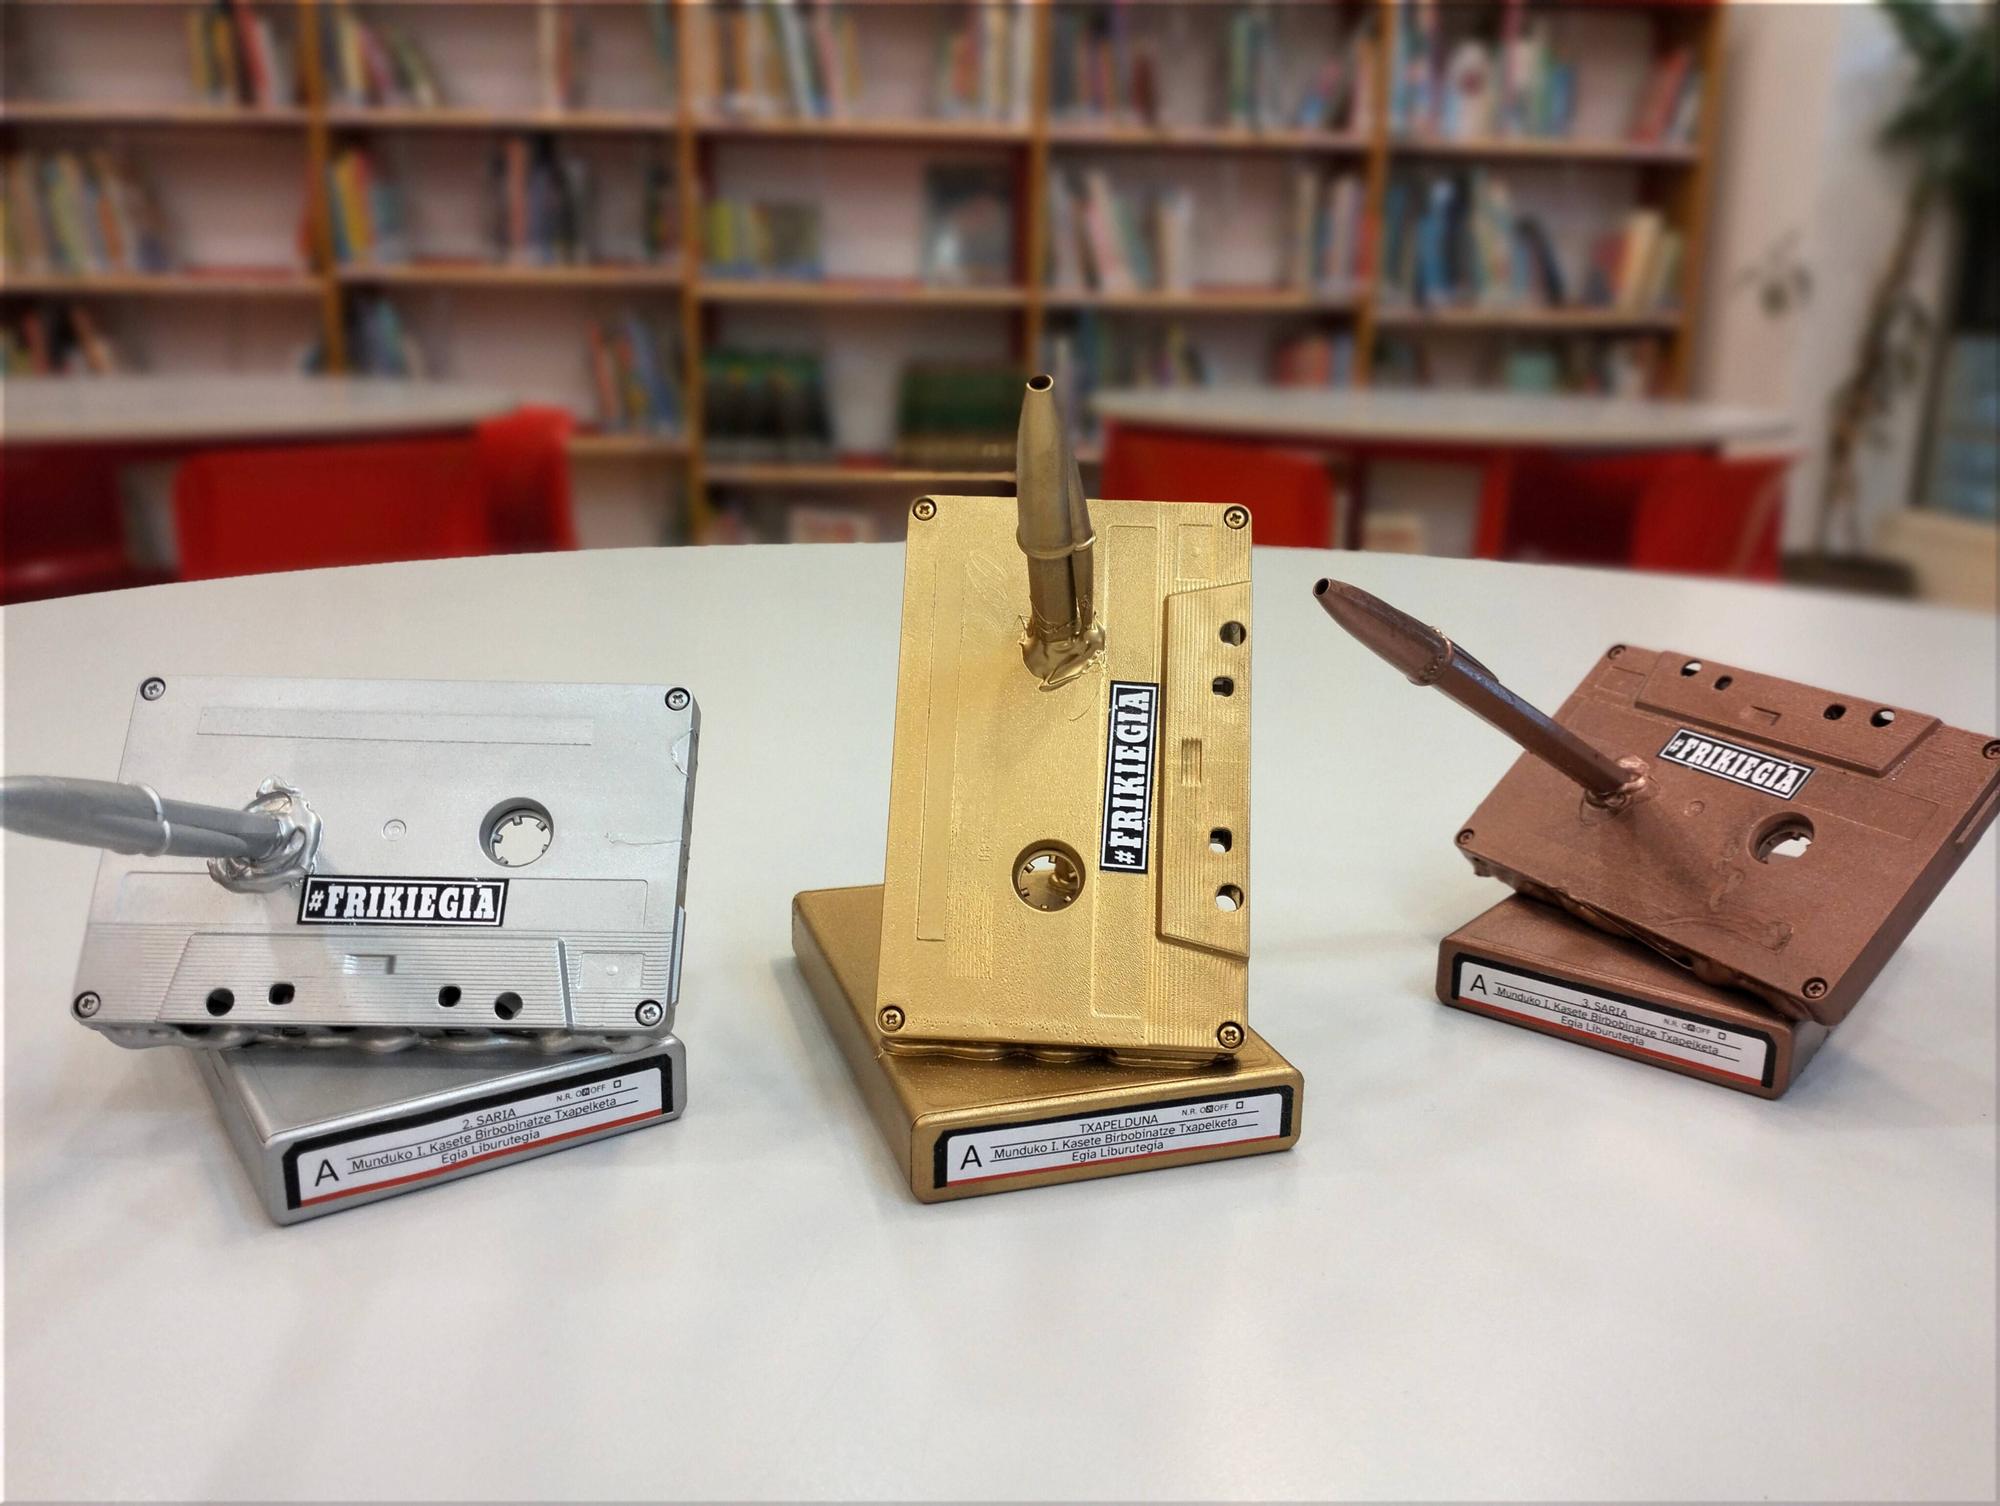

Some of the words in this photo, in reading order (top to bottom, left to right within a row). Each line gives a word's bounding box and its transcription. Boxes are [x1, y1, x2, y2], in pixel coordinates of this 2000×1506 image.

[1109, 691, 1150, 865] #FRIKIEGIA
[1667, 737, 1801, 793] #FRIKIEGIA
[308, 885, 496, 919] #FRIKIEGIA
[1470, 974, 1487, 995] A
[1496, 986, 1541, 1007] Munduko
[1553, 1001, 1588, 1019] Kasete
[1590, 1012, 1657, 1038] Birbobinatze
[1660, 1030, 1719, 1055] Txapelketa
[1594, 1001, 1628, 1018] SARIA
[1560, 1015, 1584, 1029] Egia
[1586, 1023, 1645, 1046] Liburutegia
[352, 1149, 413, 1171] Munduko
[429, 1135, 472, 1153] Kasete
[475, 1113, 551, 1140] Birbobinatze
[555, 1097, 617, 1120] Txapelketa
[462, 1119, 473, 1130] 2.
[476, 1108, 516, 1126] SARIA
[1080, 1114, 1159, 1134] TXAPELDUNA
[441, 1149, 468, 1164] Egia
[472, 1130, 541, 1155] Liburutegia
[994, 1143, 1047, 1160] Munduko
[1062, 1136, 1102, 1149] Kasete
[1105, 1123, 1176, 1144] Birbobinatze
[1179, 1117, 1238, 1133] Txapelketa
[1072, 1149, 1097, 1162] Egia
[1100, 1140, 1164, 1158] Liburutegia
[314, 1158, 340, 1188] A
[960, 1144, 983, 1171] A
